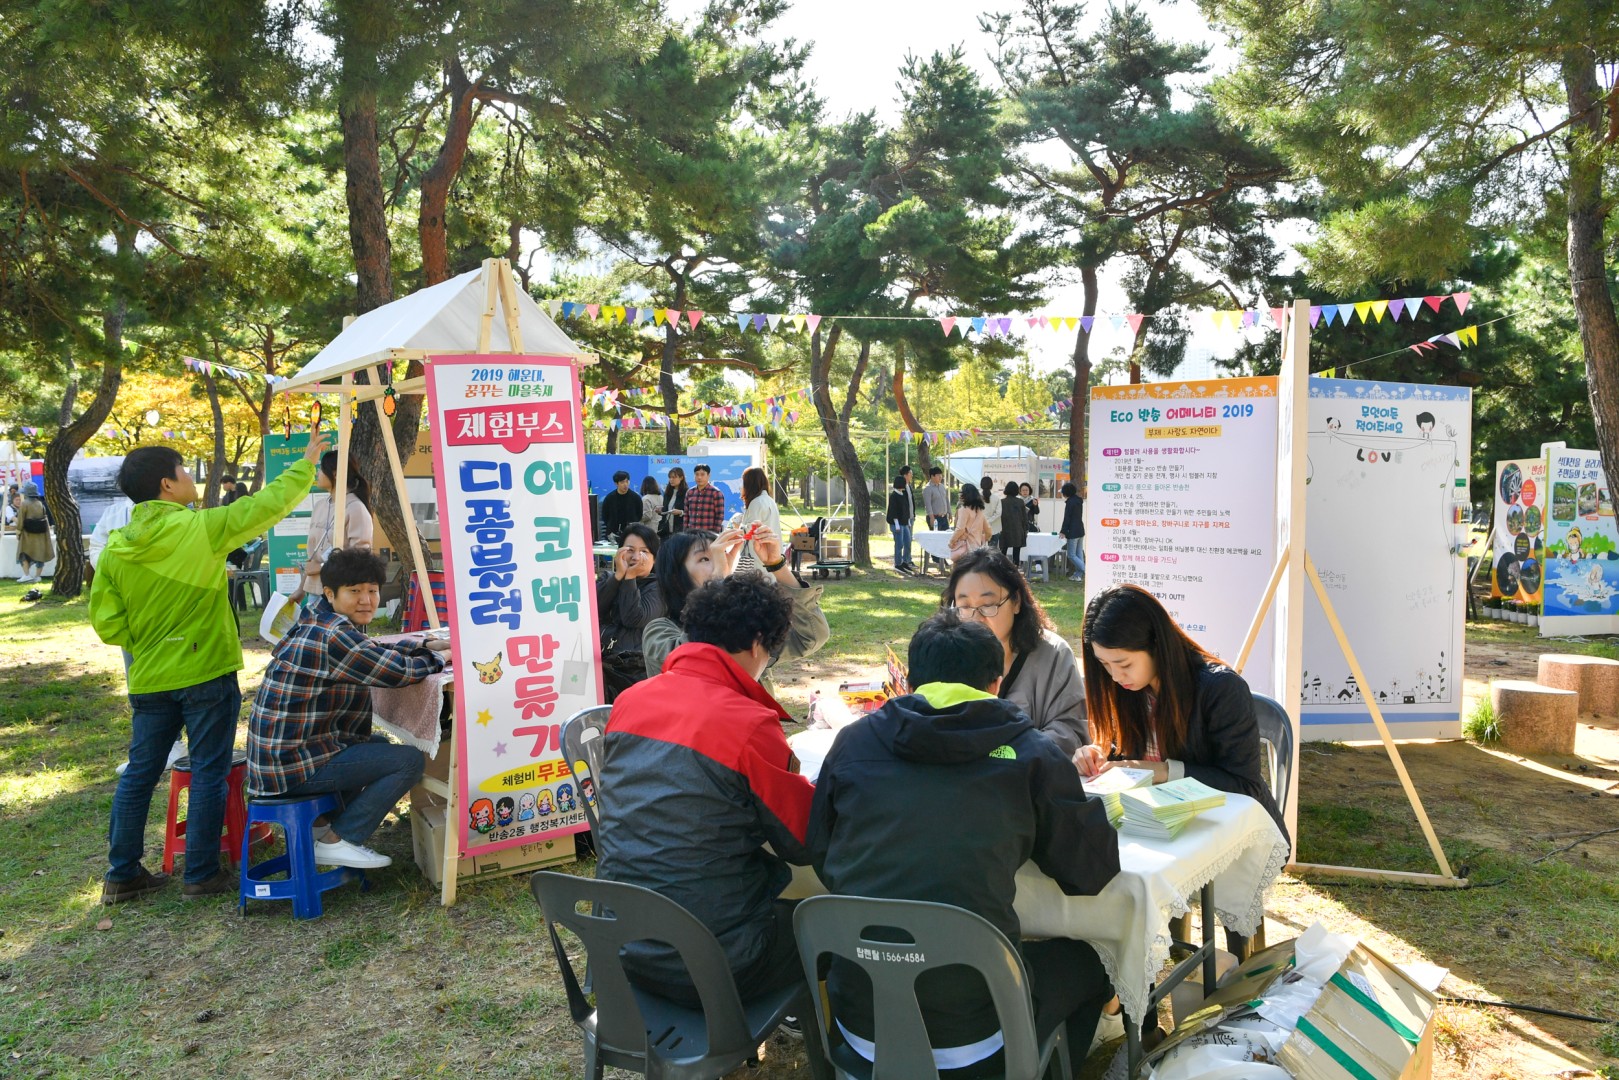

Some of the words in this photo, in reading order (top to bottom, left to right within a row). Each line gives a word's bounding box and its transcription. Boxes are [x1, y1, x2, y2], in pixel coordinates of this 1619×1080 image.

[471, 369, 504, 382] 2019
[508, 369, 545, 382] 해운대,
[465, 384, 503, 398] 꿈꾸는
[508, 384, 553, 397] 마을축제
[1110, 410, 1133, 422] Eco
[1138, 407, 1160, 422] 반송
[1166, 406, 1216, 420] 어메니티
[1222, 404, 1254, 418] 2019
[1361, 405, 1398, 419] 무엇이든
[456, 411, 564, 438] 체험부스
[1168, 428, 1187, 436] 사랑도
[1190, 427, 1218, 435] 자연이다
[1356, 420, 1403, 433] 적어주세요
[1356, 448, 1402, 464] LOVE
[1557, 469, 1580, 479] 주민들의
[459, 460, 522, 630] 디폼블럭
[524, 460, 580, 622] 에코백
[506, 634, 560, 758] 만들기
[502, 770, 534, 786] 체험비
[537, 760, 572, 782] 무료
[489, 826, 525, 842] 반송2동
[530, 812, 587, 834] 행정복지센터
[882, 952, 925, 962] 1566-4584
